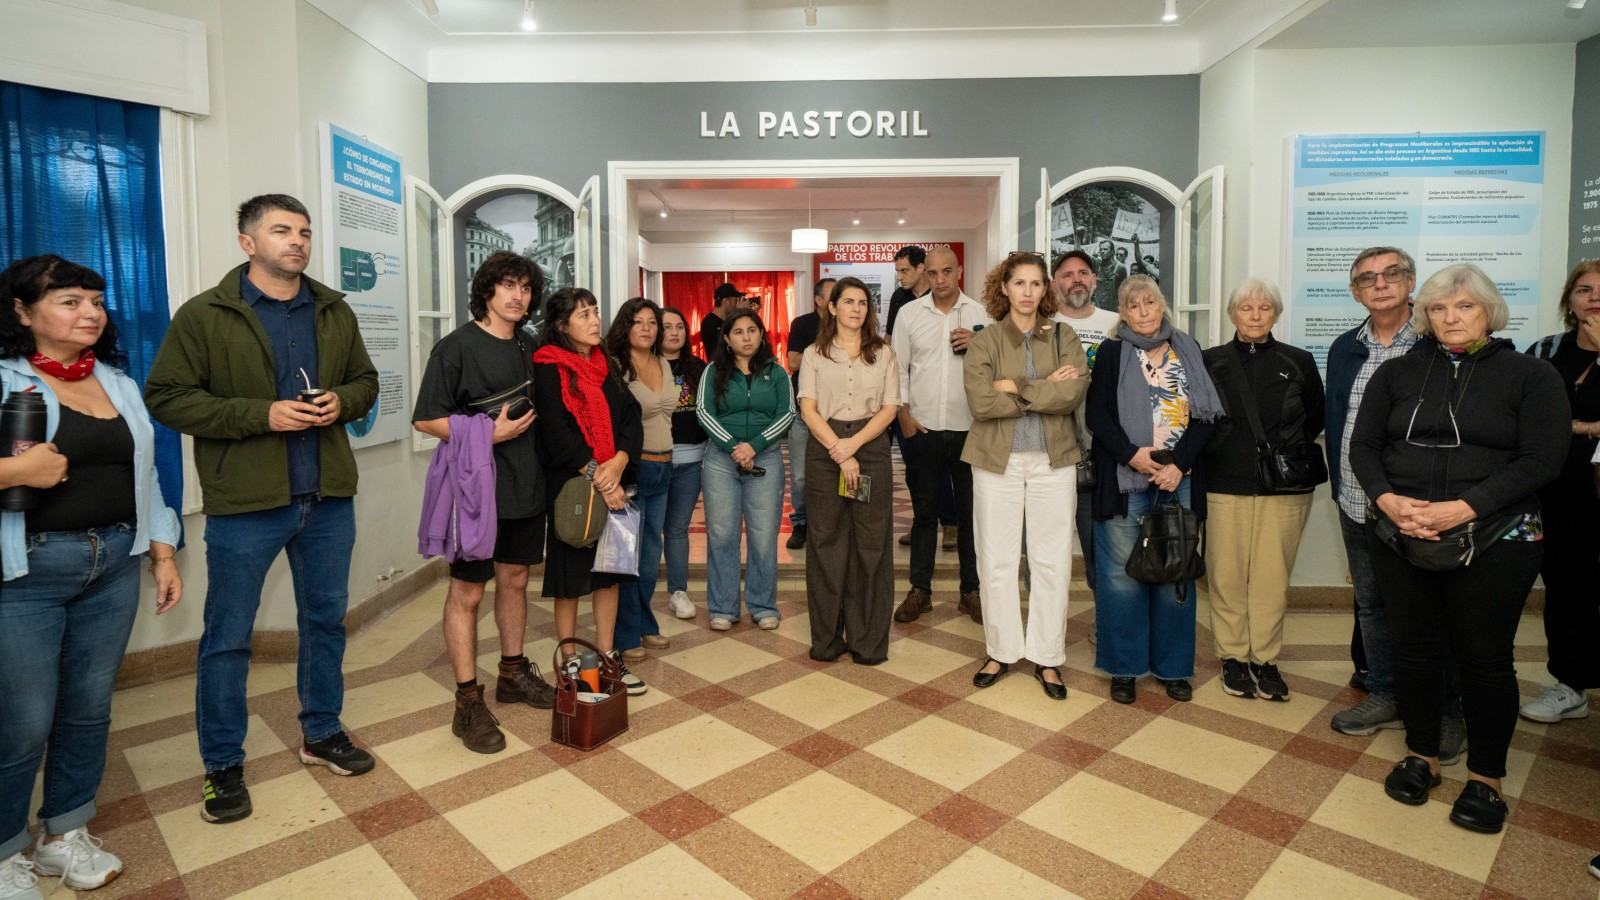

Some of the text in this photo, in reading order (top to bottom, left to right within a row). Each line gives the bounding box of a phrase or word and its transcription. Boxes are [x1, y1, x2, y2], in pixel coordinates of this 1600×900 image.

[700, 111, 928, 137] LA PASTORIL
[363, 154, 368, 163] SE
[369, 158, 393, 173] ORGANIZÓ
[346, 161, 390, 184] EL TERRORISMO DE
[344, 173, 363, 186] ESTADO
[1583, 201, 1598, 210] 1975
[1582, 225, 1591, 233] Se
[828, 244, 950, 253] PARTIDO REVOLNARO
